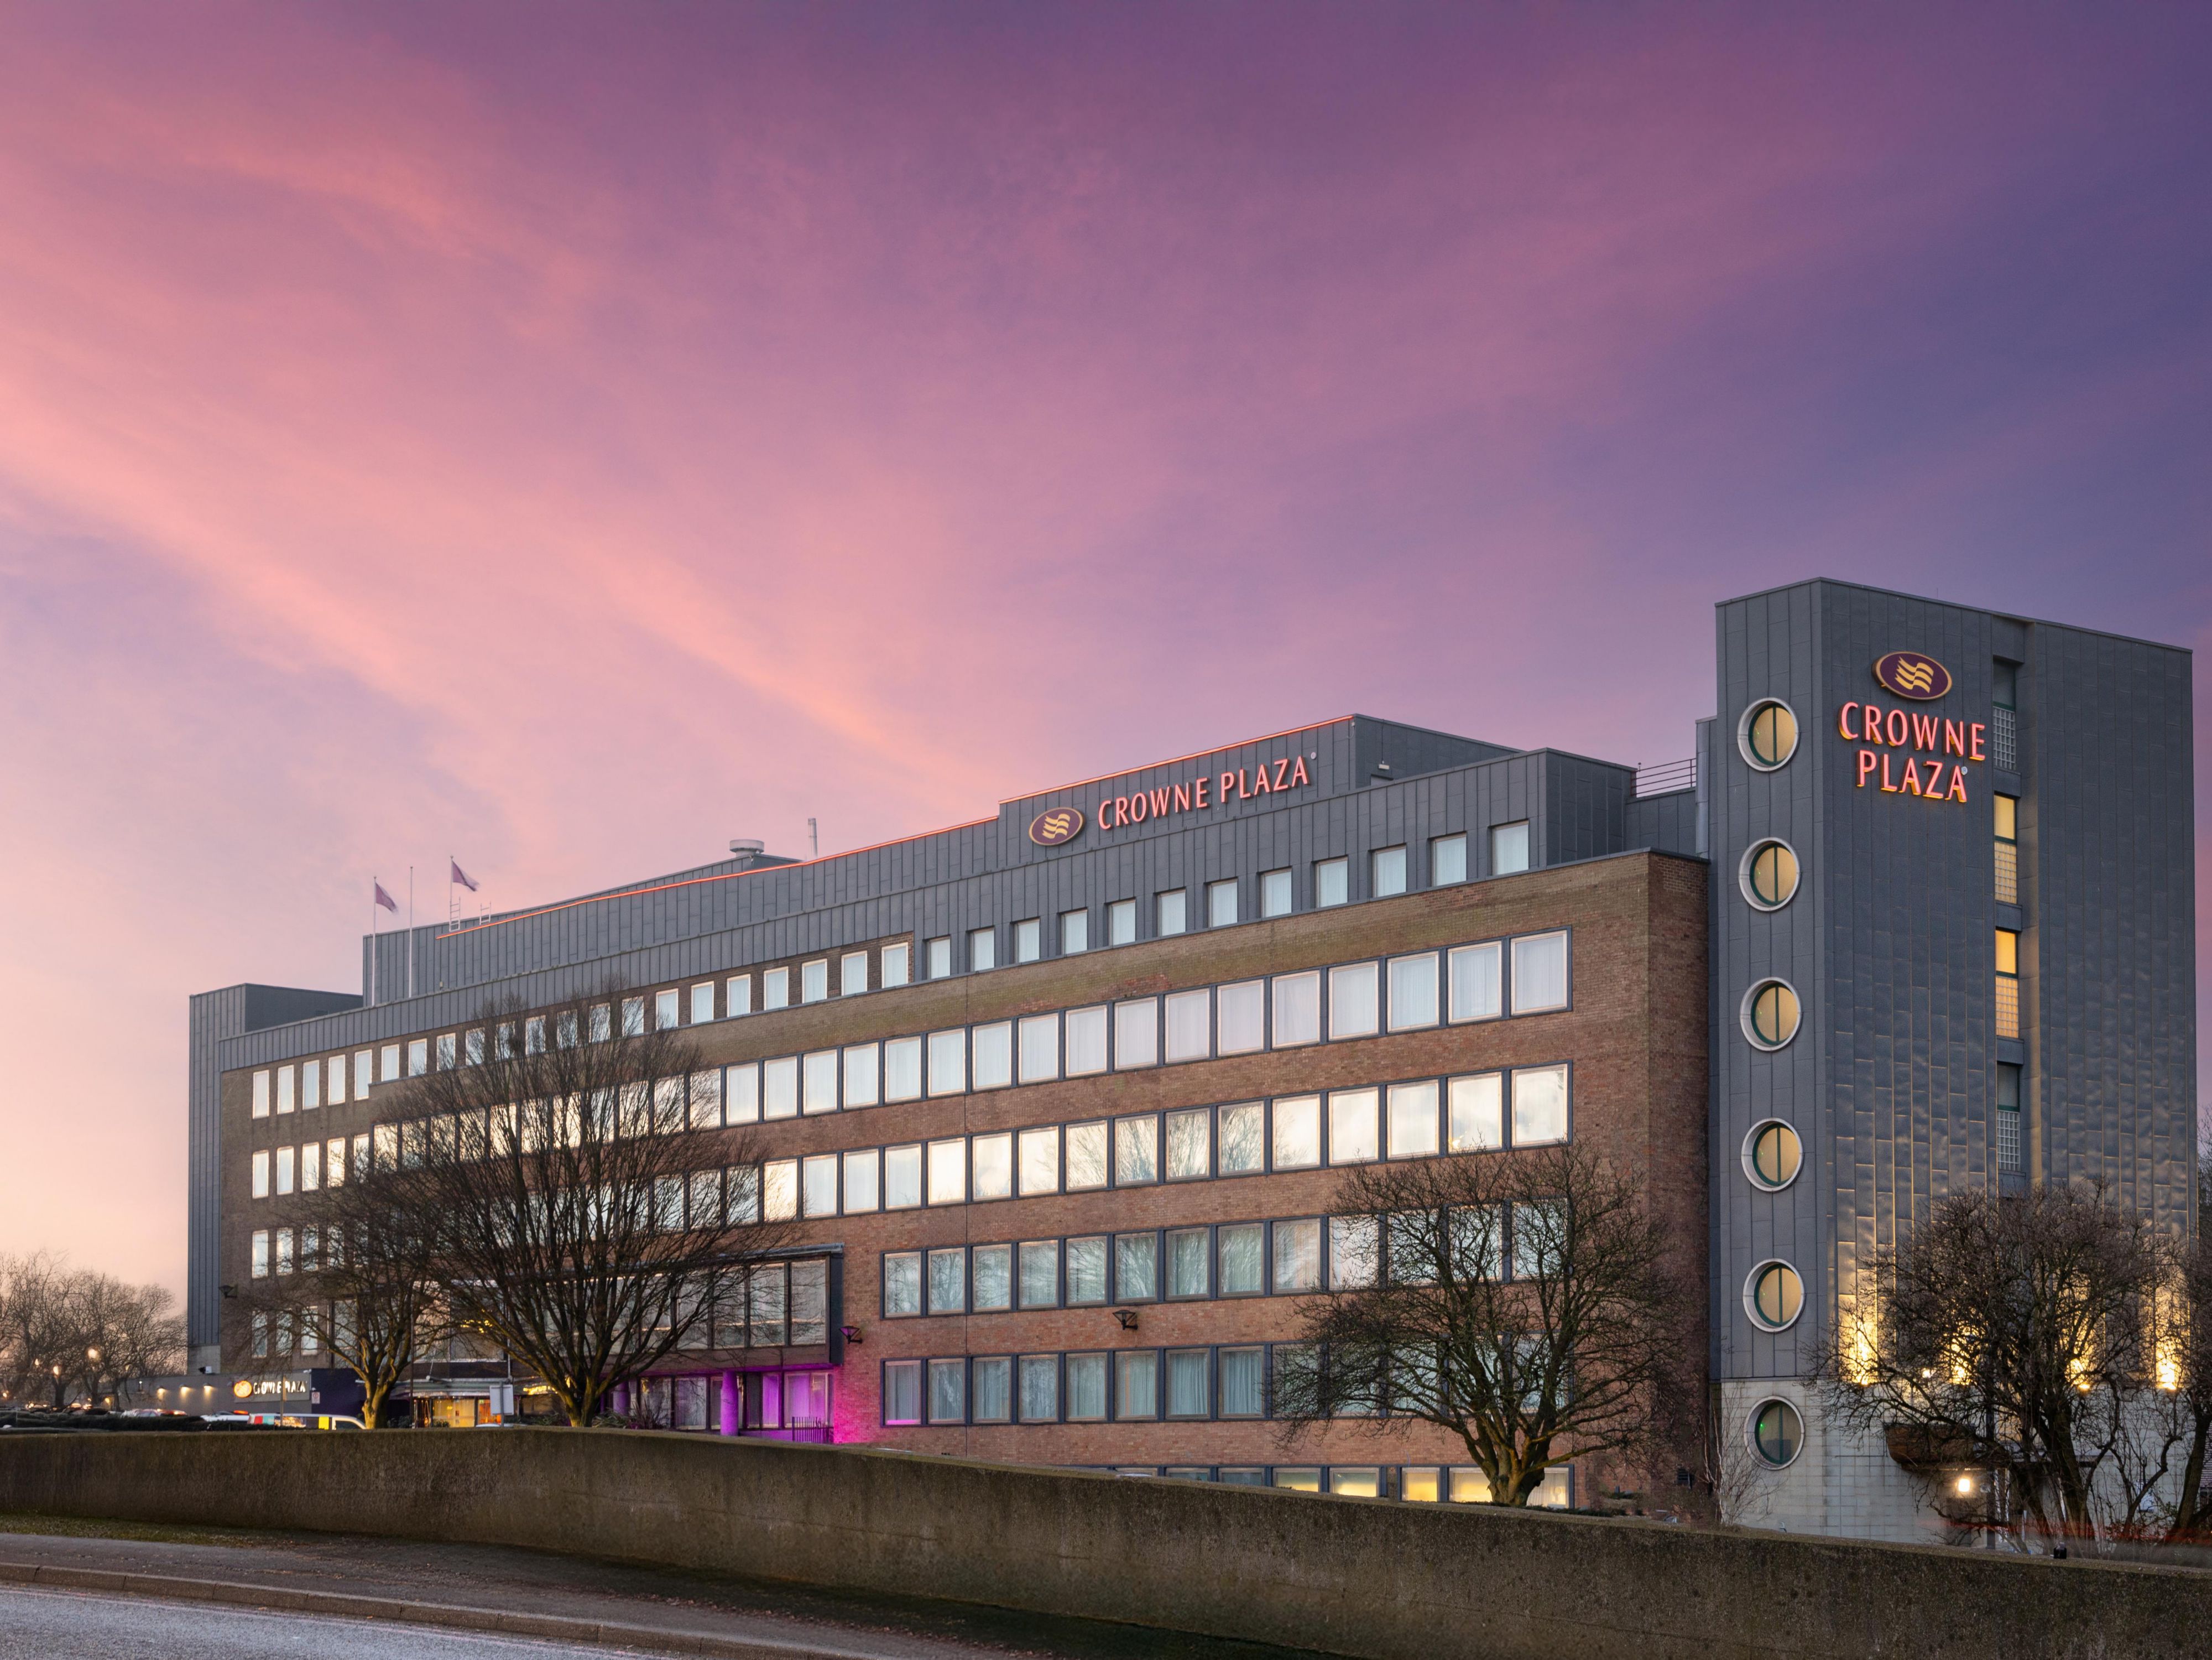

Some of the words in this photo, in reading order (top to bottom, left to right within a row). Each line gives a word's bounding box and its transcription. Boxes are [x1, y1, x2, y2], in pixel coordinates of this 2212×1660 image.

[1838, 701, 1985, 761] CROWNE
[1098, 777, 1209, 830] CROWNE
[1220, 756, 1311, 803] PLAZA
[1856, 750, 1968, 803] PLAZA
